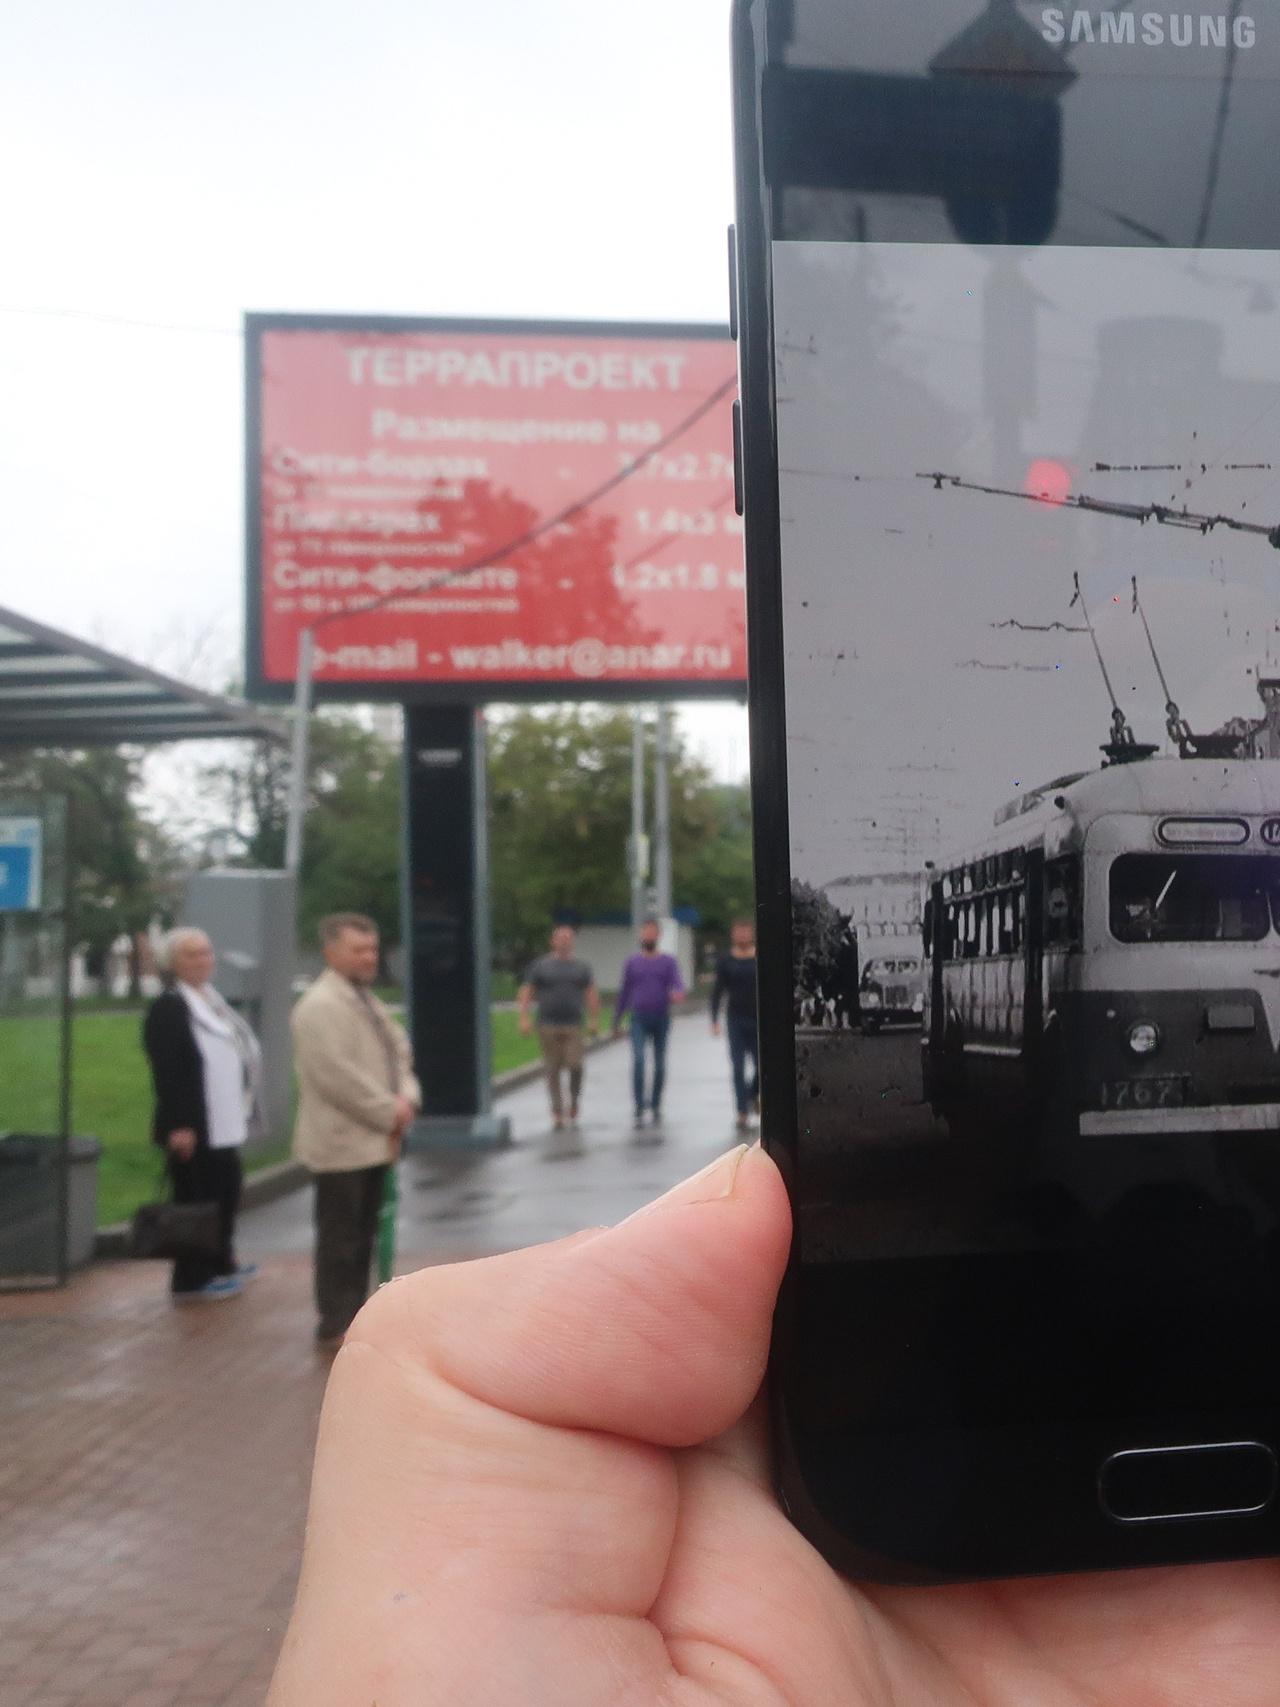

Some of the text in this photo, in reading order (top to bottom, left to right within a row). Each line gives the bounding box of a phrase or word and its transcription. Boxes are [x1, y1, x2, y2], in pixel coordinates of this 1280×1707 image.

[1041, 9, 1256, 48] SAMSUNG
[345, 348, 686, 390] ТЕРРАПРОЕКТ
[371, 408, 662, 446] Размещение на
[448, 638, 733, 679] walker@anar.ru
